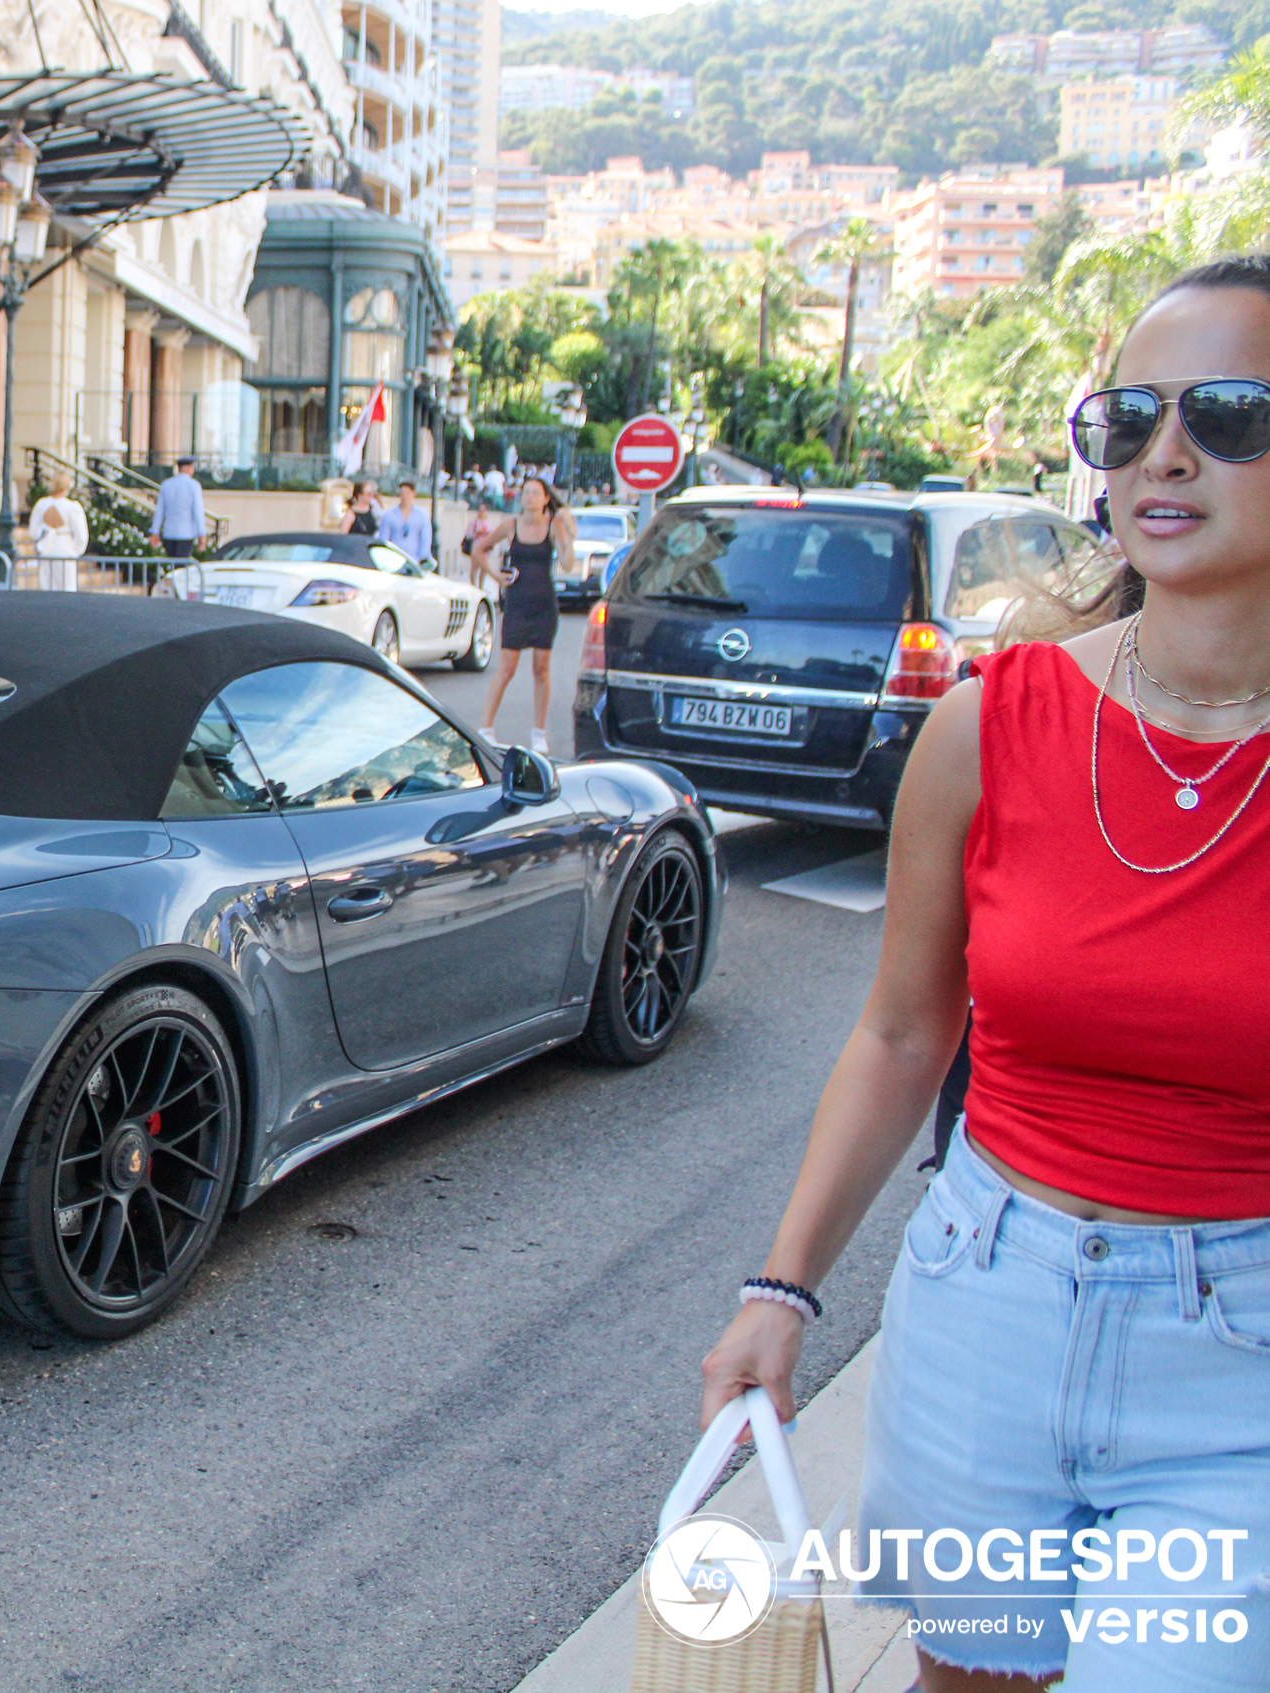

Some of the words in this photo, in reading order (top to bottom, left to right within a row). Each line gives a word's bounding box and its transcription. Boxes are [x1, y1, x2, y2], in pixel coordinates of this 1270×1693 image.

[685, 701, 718, 724] 794
[723, 706, 758, 728] BZW
[763, 709, 787, 730] 06
[127, 994, 149, 1009] SPORT
[42, 1026, 103, 1139] MICHELIN
